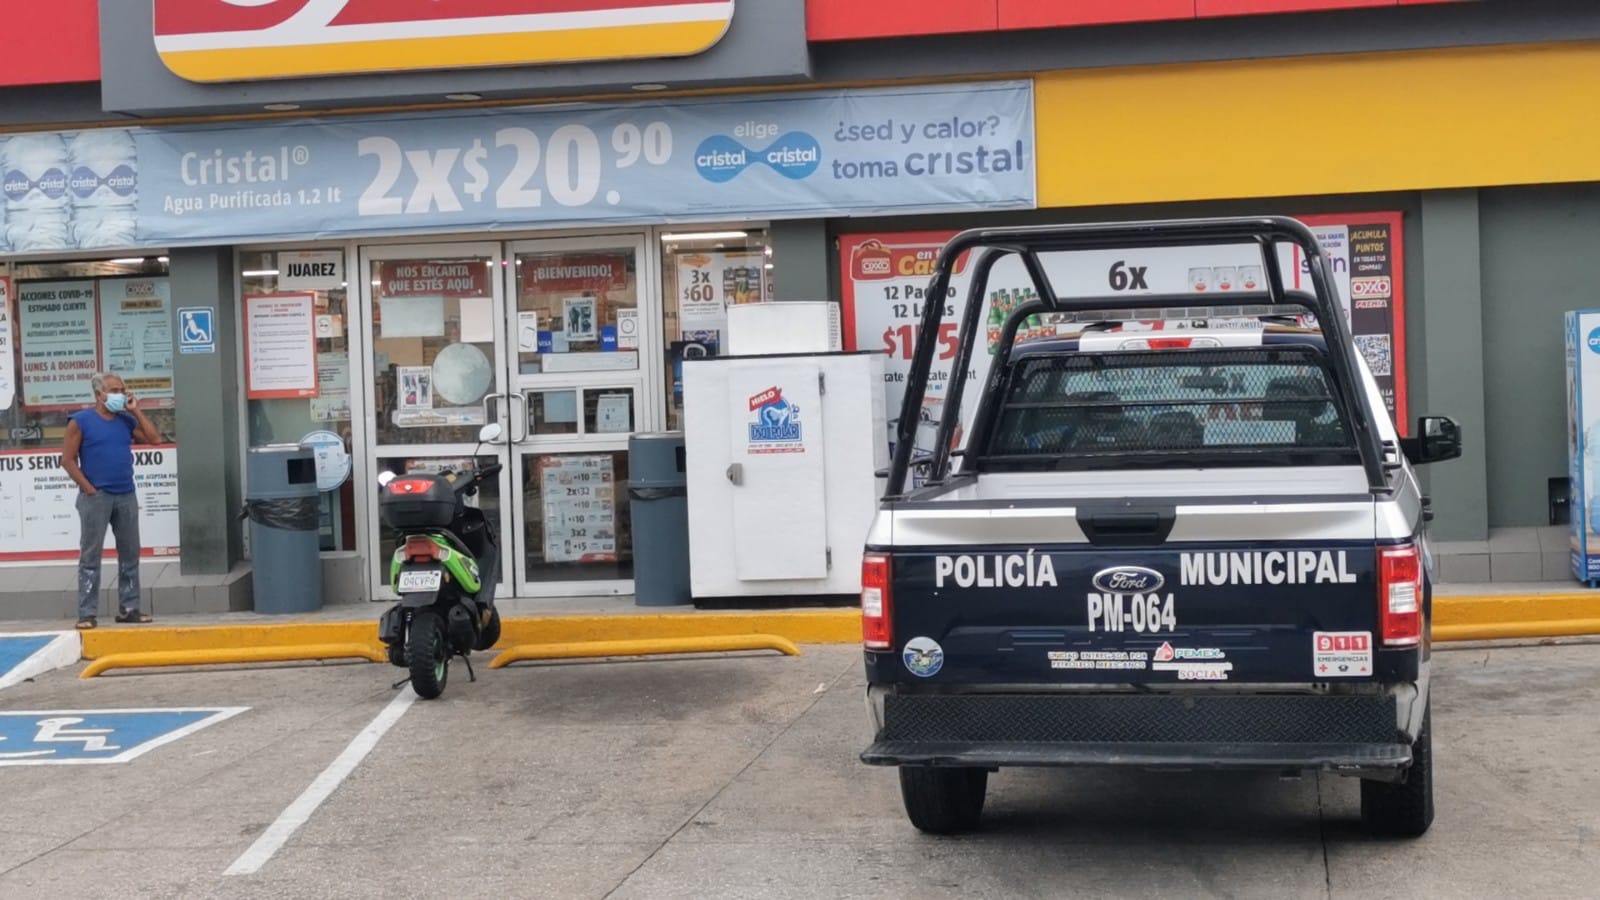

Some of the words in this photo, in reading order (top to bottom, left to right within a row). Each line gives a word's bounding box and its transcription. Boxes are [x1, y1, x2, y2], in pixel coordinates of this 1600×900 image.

[734, 121, 779, 141] elige
[834, 119, 892, 142] ¿sed
[900, 123, 916, 143] y
[922, 115, 1000, 140] calor?
[697, 150, 746, 167] cristal
[767, 146, 816, 164] cristal
[832, 160, 899, 180] toma
[904, 139, 1024, 176] cristal
[4, 177, 30, 192] cristal
[39, 176, 66, 191] cristal
[71, 174, 98, 190] cristal
[108, 173, 135, 188] cristal
[163, 195, 203, 215] Agua
[210, 189, 292, 210] Purificada
[299, 188, 321, 205] 1.2
[1350, 229, 1387, 242] ¡ACUMULA
[1355, 242, 1385, 253] PUNTOS
[917, 251, 932, 261] en
[287, 262, 337, 278] JUAREZ
[396, 266, 418, 278] NOS
[421, 265, 470, 277] ENCANTA
[533, 264, 613, 283] ¡BIENVENIDO!
[690, 268, 712, 284] 3x
[1108, 260, 1149, 291] 6x
[388, 280, 409, 293] QUE
[413, 278, 444, 292] ESTÉS
[446, 277, 475, 291] AQUÍ
[683, 284, 714, 302] $60
[884, 286, 899, 300] 12
[1352, 280, 1390, 296] OXXO
[21, 290, 57, 301] ACCIONES
[58, 288, 94, 300] COVID-19
[28, 303, 62, 313] ESTIMADO
[63, 301, 87, 312] CLIENTE
[893, 305, 908, 318] 12
[883, 322, 960, 360] $15
[24, 361, 49, 373] LUNES
[50, 360, 57, 371] A
[58, 359, 96, 371] DOMINGO
[935, 548, 1058, 588] POLICÍA
[1179, 550, 1357, 586] MUNICIPAL
[1108, 571, 1148, 589] Ford
[1087, 592, 1177, 633] PM-064
[1319, 636, 1366, 650] 911
[1316, 656, 1369, 664] EMERGENCIAS
[1178, 670, 1227, 680] SOCIAL
